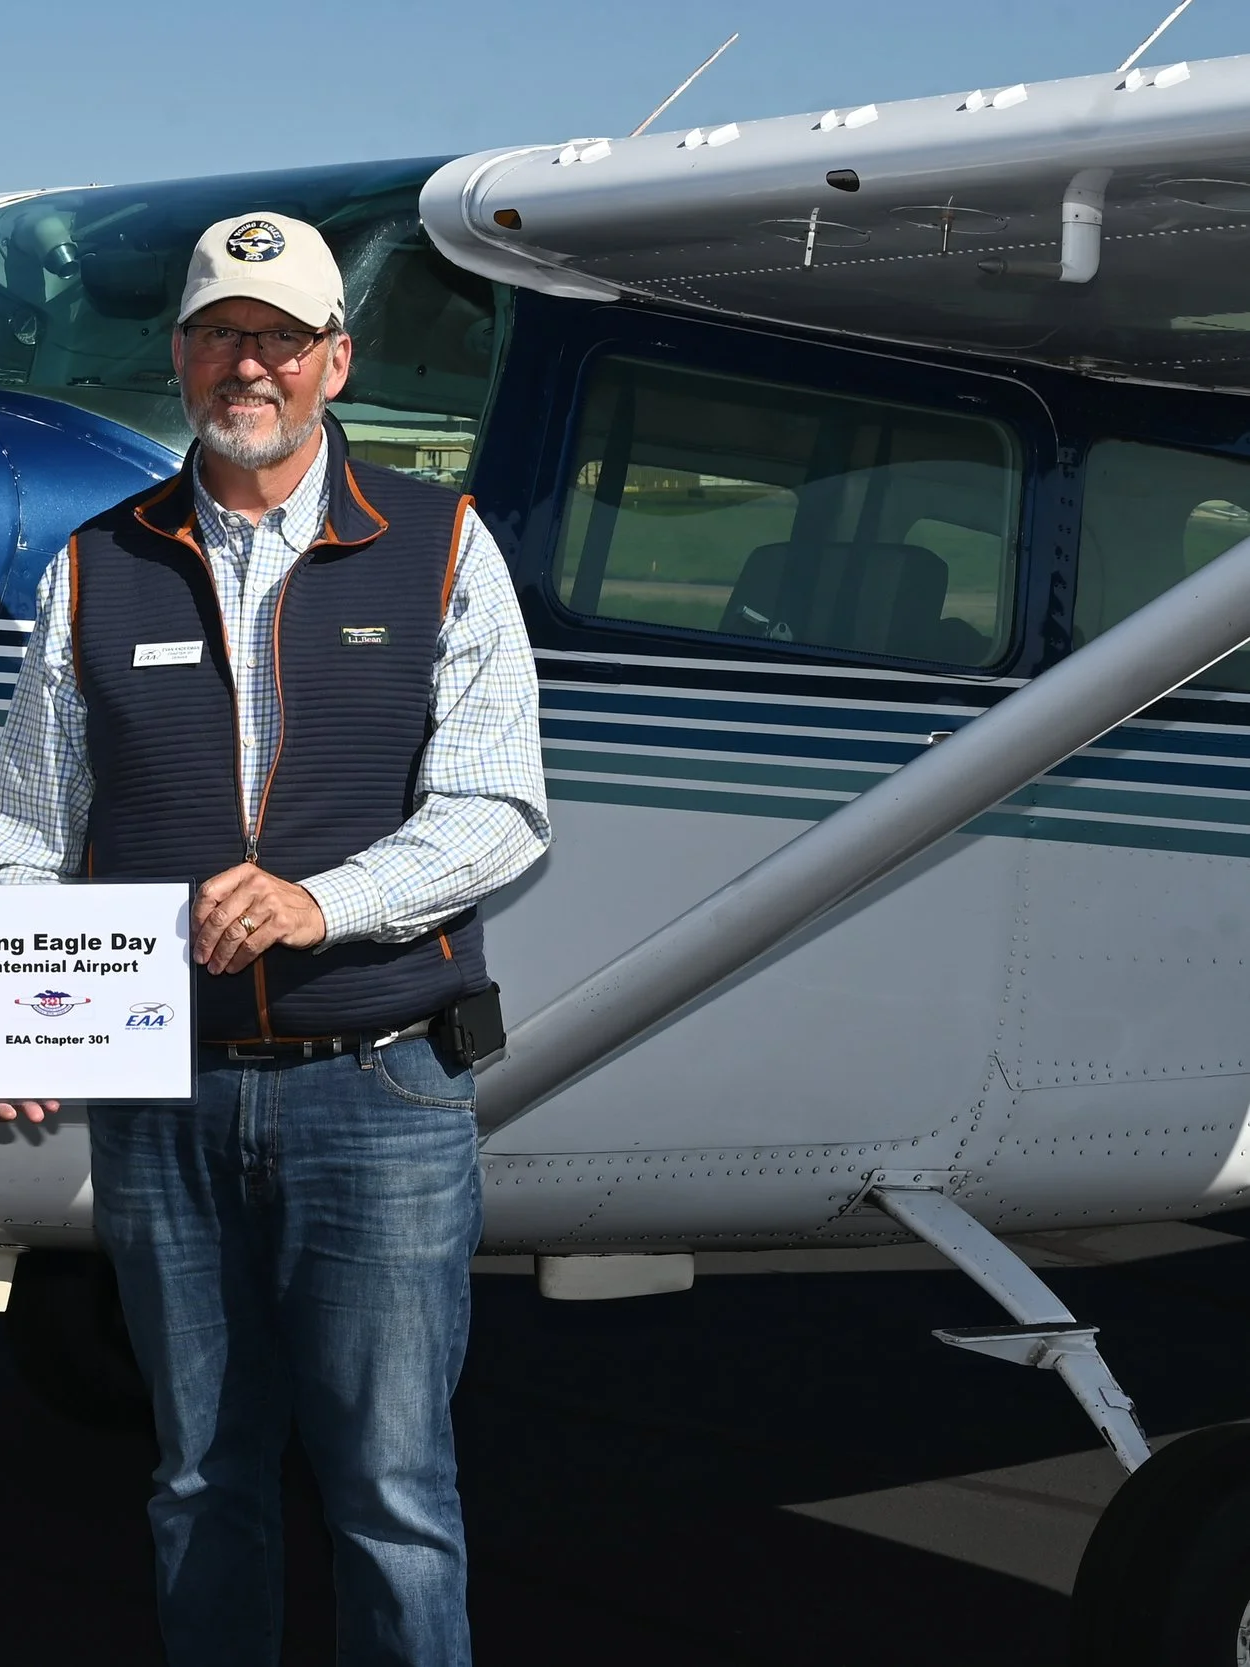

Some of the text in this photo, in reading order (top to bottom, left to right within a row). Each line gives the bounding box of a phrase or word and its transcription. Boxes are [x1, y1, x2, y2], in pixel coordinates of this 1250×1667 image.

[233, 222, 282, 239] YOUNG EAGLES
[34, 933, 102, 955] Eagle
[111, 933, 157, 955] Day
[73, 960, 139, 976] Airport
[126, 1015, 164, 1026] EAA
[6, 1034, 110, 1046] EAA Chapter 301
